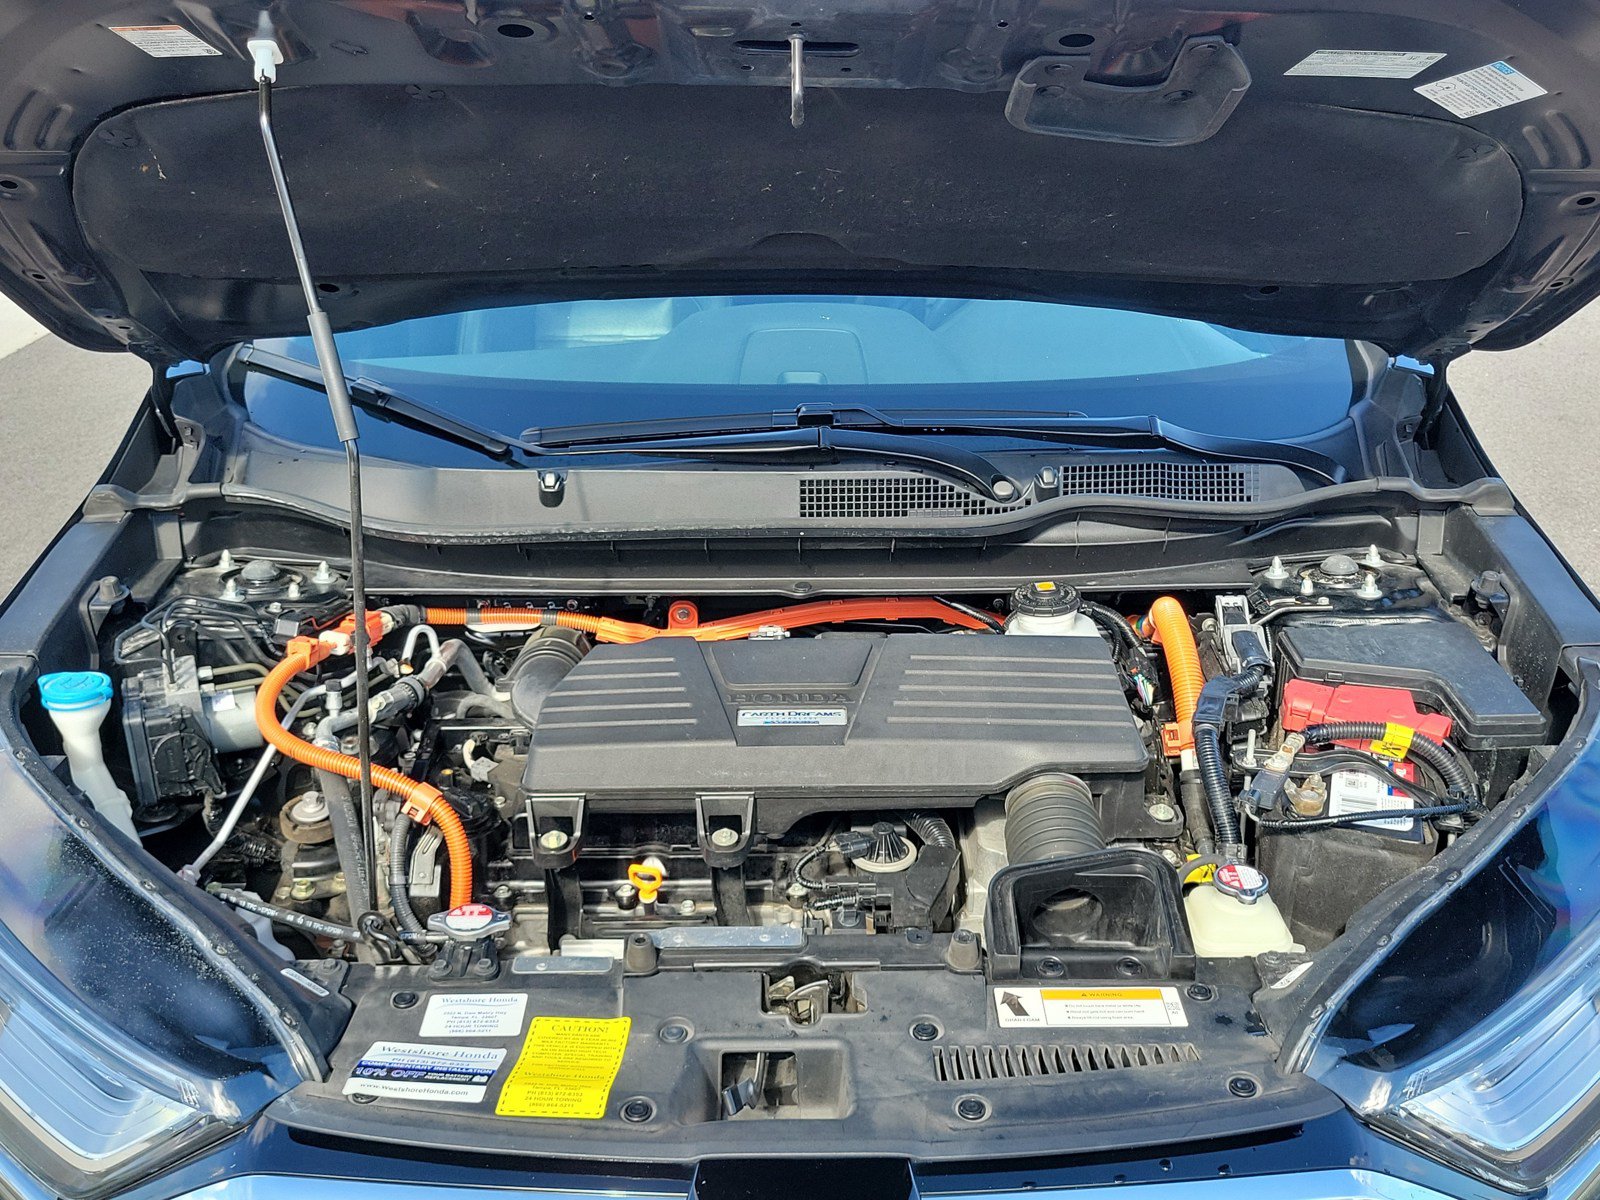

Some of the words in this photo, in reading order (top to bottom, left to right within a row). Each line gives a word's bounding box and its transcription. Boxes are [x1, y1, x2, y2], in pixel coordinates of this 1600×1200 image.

[726, 692, 856, 704] HONDA
[552, 1025, 609, 1033] CAUTION!
[381, 1046, 450, 1058] Westshore
[454, 1049, 499, 1060] Honda
[355, 1067, 388, 1077] 10%
[391, 1070, 426, 1079] OFF
[361, 1060, 433, 1070] COMPLIMENTARY
[434, 1065, 493, 1074] INSTALLATION
[360, 1083, 469, 1096] www.WestshoreHonda.com
